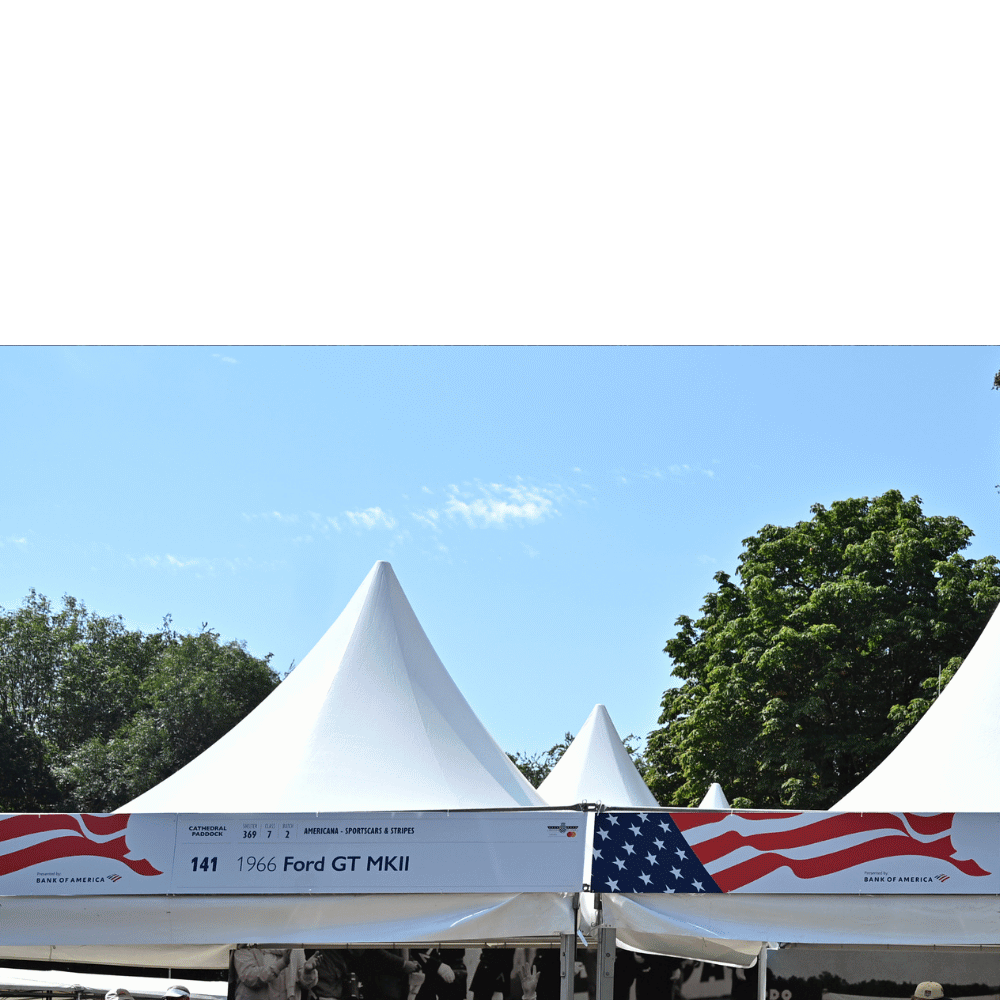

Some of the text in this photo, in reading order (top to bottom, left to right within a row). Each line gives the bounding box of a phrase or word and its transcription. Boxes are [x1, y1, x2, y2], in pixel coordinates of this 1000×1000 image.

[242, 830, 290, 839] 369 7 2
[303, 827, 339, 835] AMERICANA
[345, 827, 382, 835] SPORTSCARS
[384, 827, 389, 835] &
[390, 827, 415, 835] STRIPES
[190, 856, 218, 872] 141
[237, 855, 410, 872] 1966 Ford GT MKII
[768, 988, 792, 1000] DO
